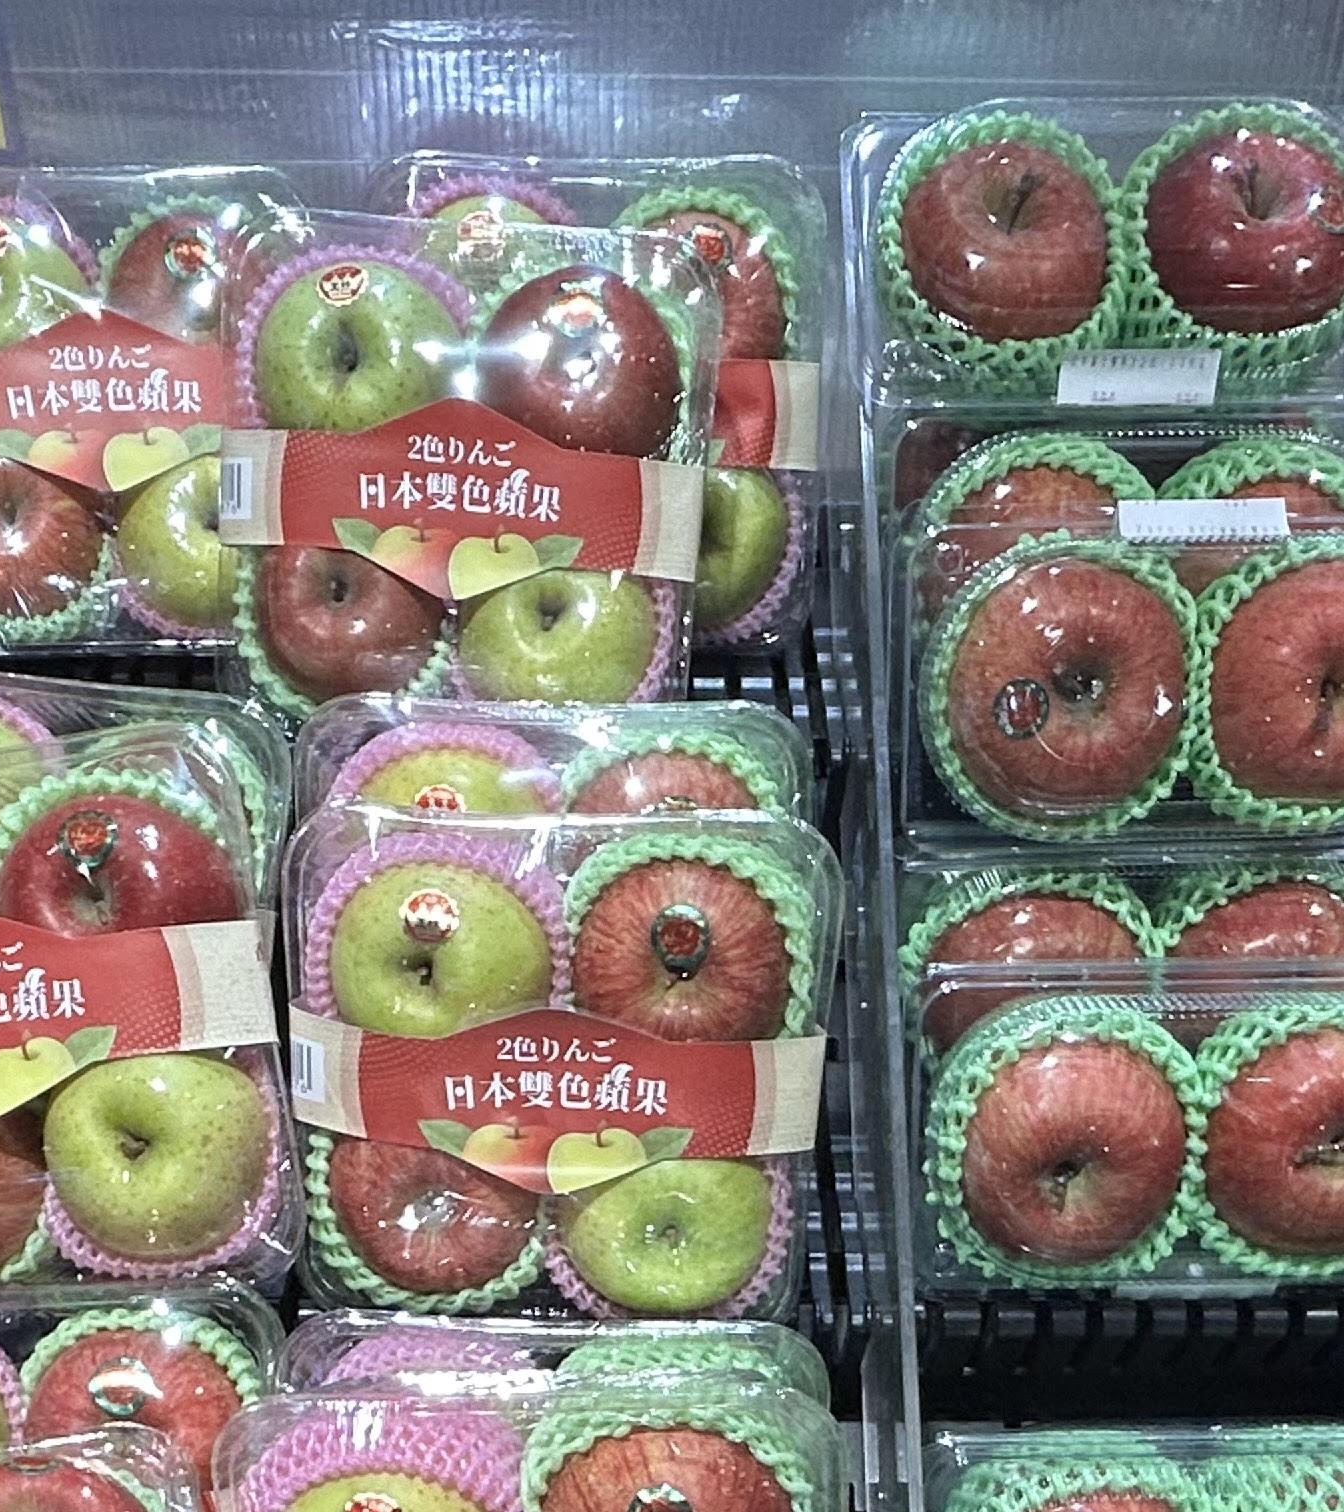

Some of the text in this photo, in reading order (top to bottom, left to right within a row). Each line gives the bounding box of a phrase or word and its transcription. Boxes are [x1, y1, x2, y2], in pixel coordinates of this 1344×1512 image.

[50, 344, 151, 372] 2色りんご
[7, 369, 201, 418] 日本雙色蘋果
[407, 435, 512, 467] 2色りんご
[357, 467, 561, 522] 日本雙色蘋果
[496, 1036, 616, 1061] 2色りんご
[444, 1062, 667, 1115] 日本雙色蘋果
